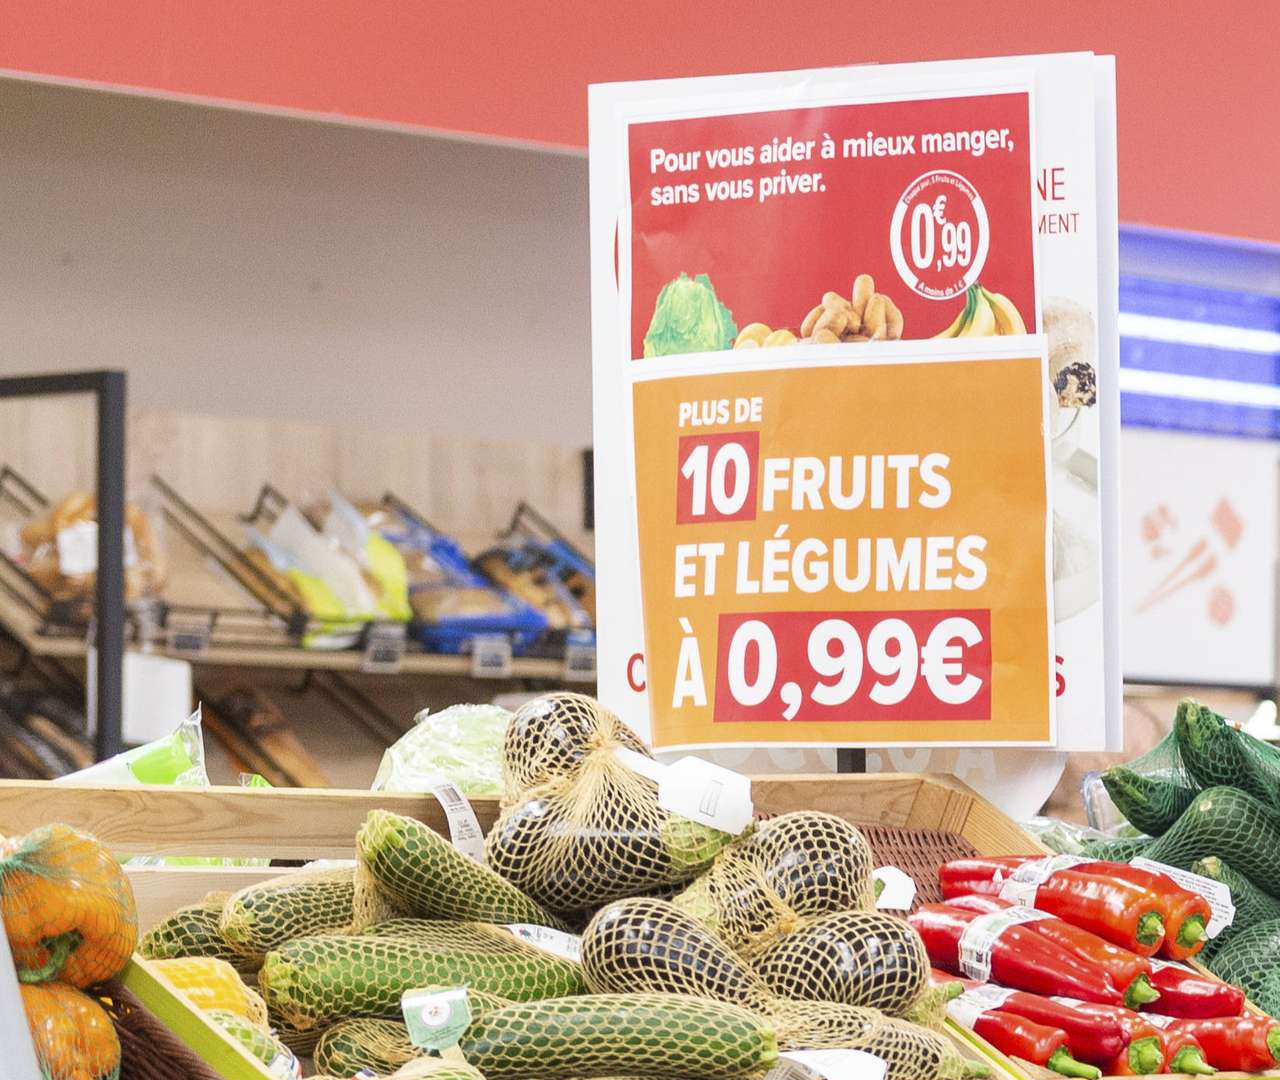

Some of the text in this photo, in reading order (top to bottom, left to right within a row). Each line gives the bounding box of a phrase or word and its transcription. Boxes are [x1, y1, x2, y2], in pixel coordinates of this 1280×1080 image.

[650, 128, 1014, 173] Pour vous aider à mieux manger,
[650, 171, 826, 206] sans vous priver.
[678, 396, 763, 427] PLUS DE
[680, 441, 952, 516] 10 FRUITS
[674, 524, 989, 598] ET LÉGUMES
[672, 618, 707, 708] À
[726, 617, 983, 721] 0,99€
